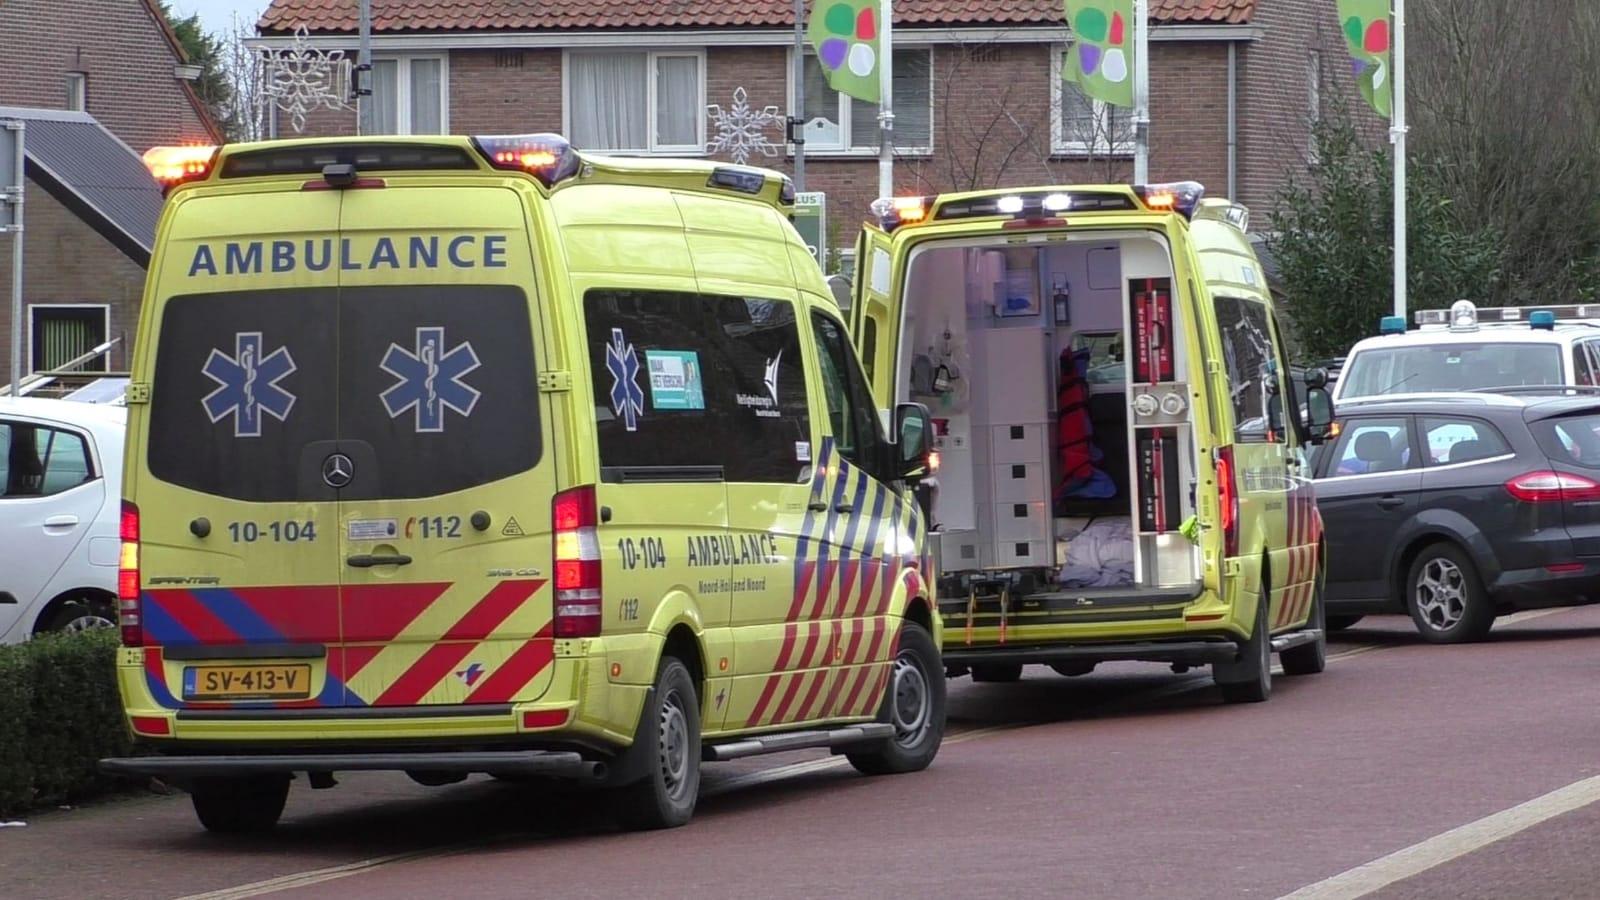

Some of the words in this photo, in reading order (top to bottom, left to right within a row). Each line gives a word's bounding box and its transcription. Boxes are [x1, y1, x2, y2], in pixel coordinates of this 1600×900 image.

[795, 195, 817, 204] LUS
[188, 235, 507, 277] AMBULANCE
[228, 521, 317, 542] 10-104
[419, 516, 462, 538] 1-1-2
[618, 537, 666, 570] 10-104
[688, 534, 779, 567] AMBULANCE
[205, 670, 297, 691] SV-413-V
